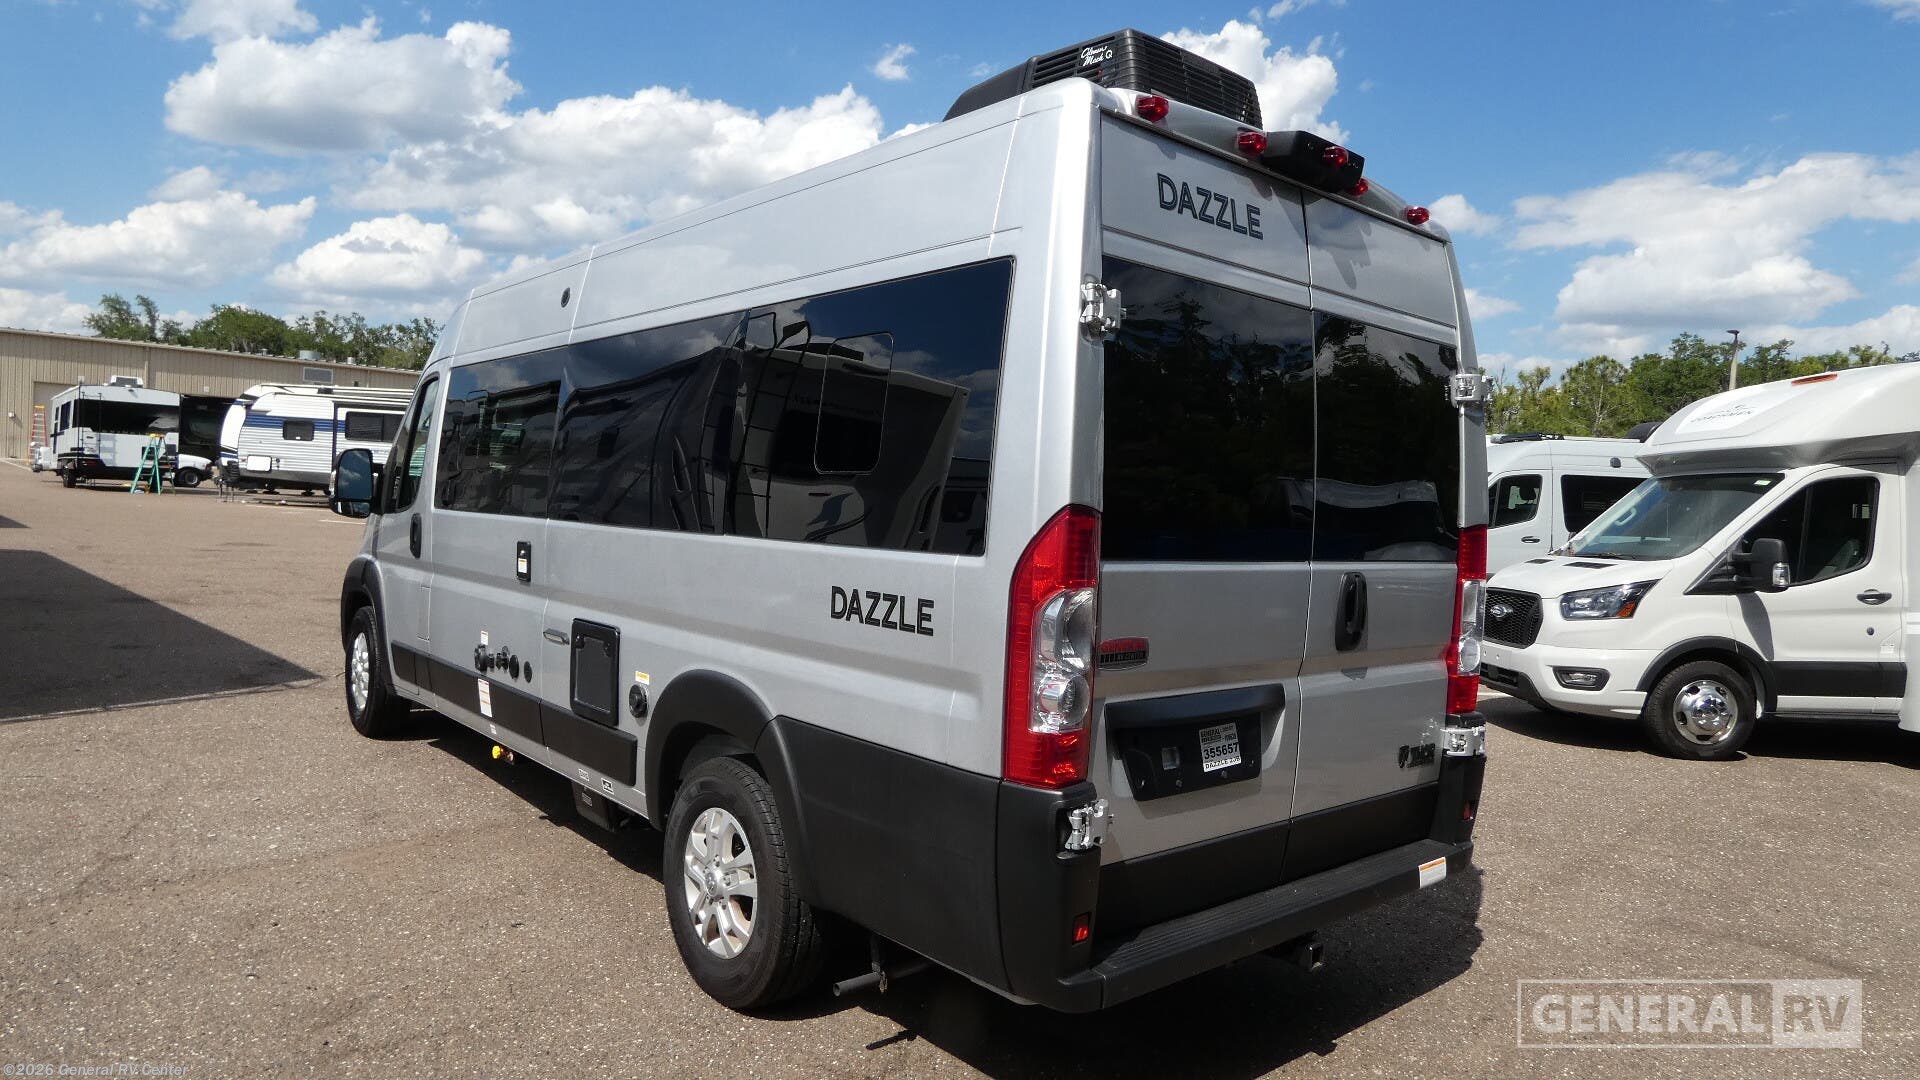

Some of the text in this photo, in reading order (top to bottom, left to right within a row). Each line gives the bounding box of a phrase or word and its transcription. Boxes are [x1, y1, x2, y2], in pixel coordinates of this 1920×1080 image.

[1157, 172, 1263, 240] DAZZLE
[831, 585, 935, 636] DAZZLE
[1203, 743, 1238, 759] 355657
